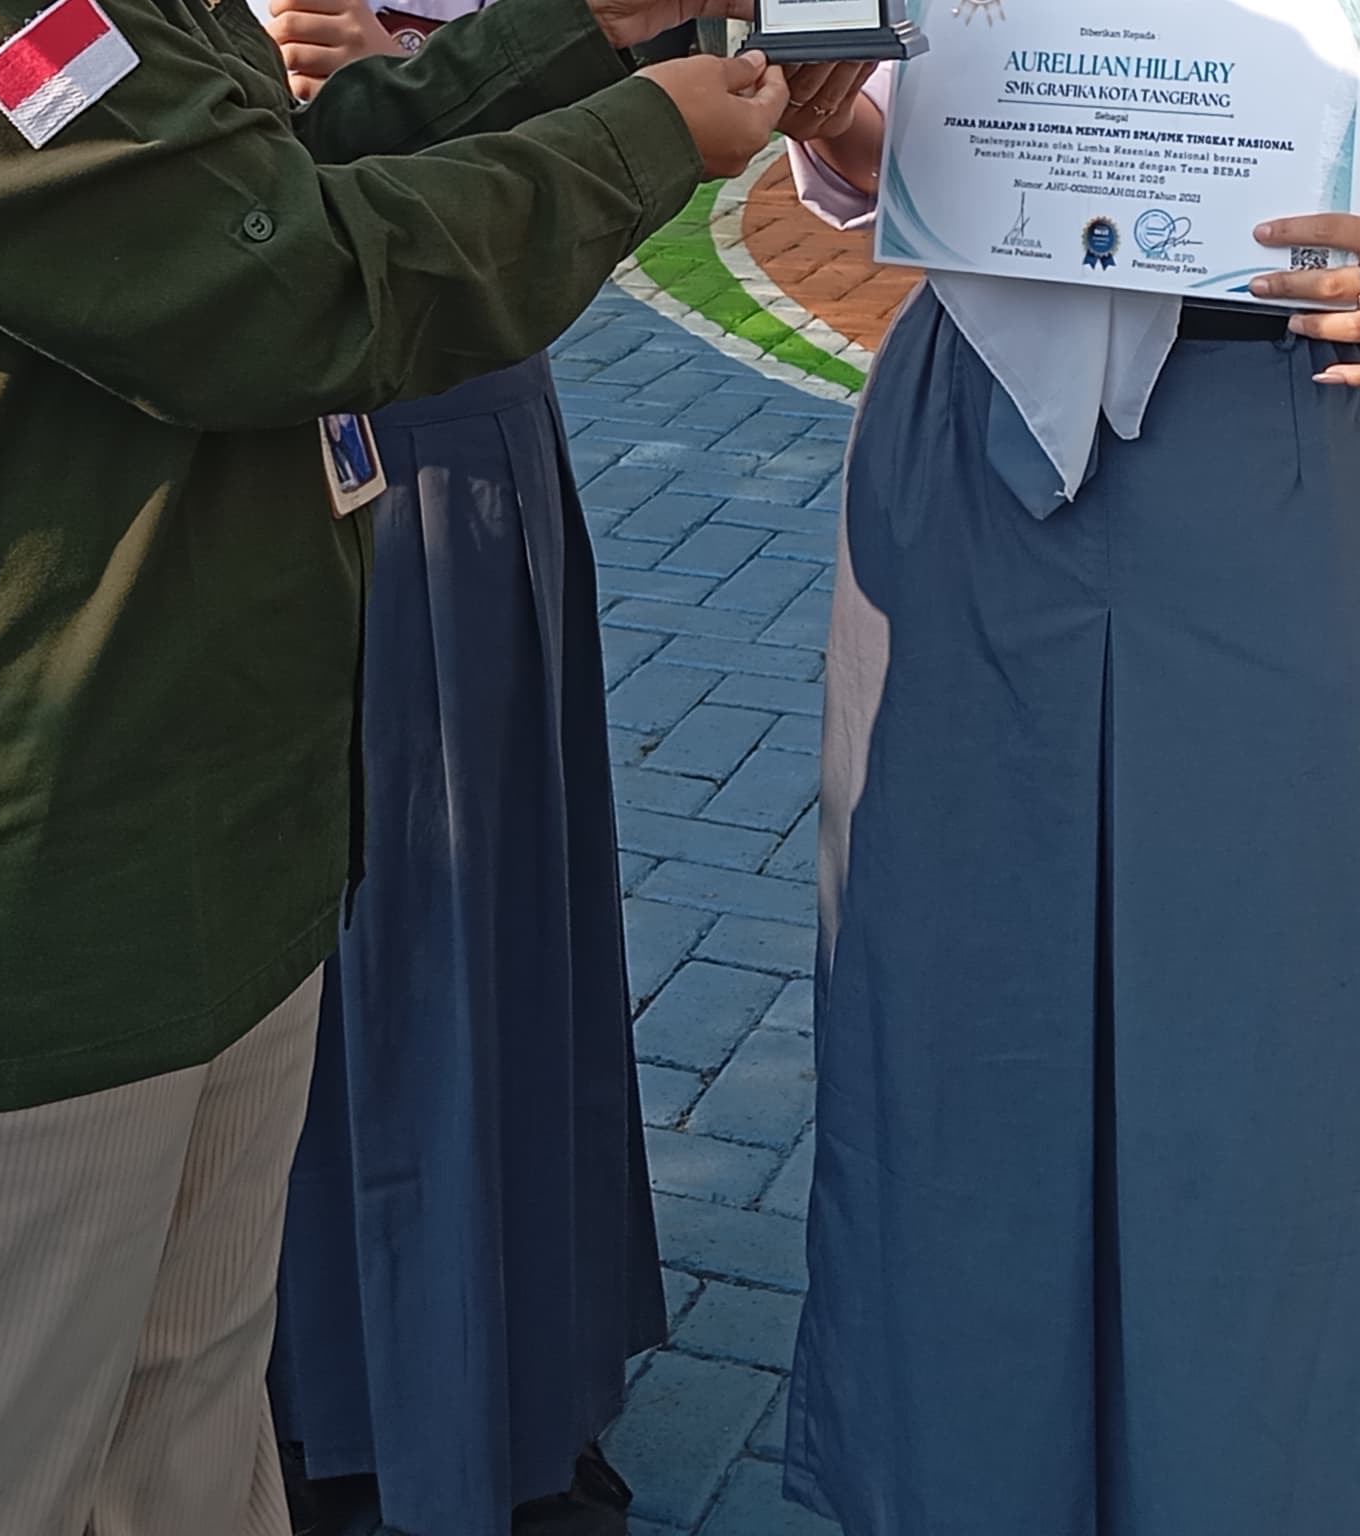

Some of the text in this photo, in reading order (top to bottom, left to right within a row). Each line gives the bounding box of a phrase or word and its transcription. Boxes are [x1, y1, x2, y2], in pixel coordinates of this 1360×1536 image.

[1004, 50, 1236, 84] AURELLIAN HILLARY
[1005, 81, 1231, 108] SMK GRAFIKA KOTA TANGERANG
[944, 117, 976, 128] JUARA
[978, 119, 1026, 131] HARAPAN
[1037, 123, 1073, 135] LOMBA
[1075, 126, 1130, 139] MENYANYI
[1133, 130, 1184, 143] SMA/SMK
[1186, 134, 1235, 147] TINGKAT
[1237, 138, 1295, 151] NASIONAL
[969, 135, 1049, 150] Diselenggarakan
[1052, 141, 1074, 151] oleh
[1114, 145, 1160, 157] Kesenian
[1164, 149, 1210, 161] Nasional
[1213, 153, 1258, 165] bersama
[974, 148, 1250, 178] Penerbit Aksara Pilar Nusantara dengan Tema BEBAS
[1106, 172, 1136, 182] Maret
